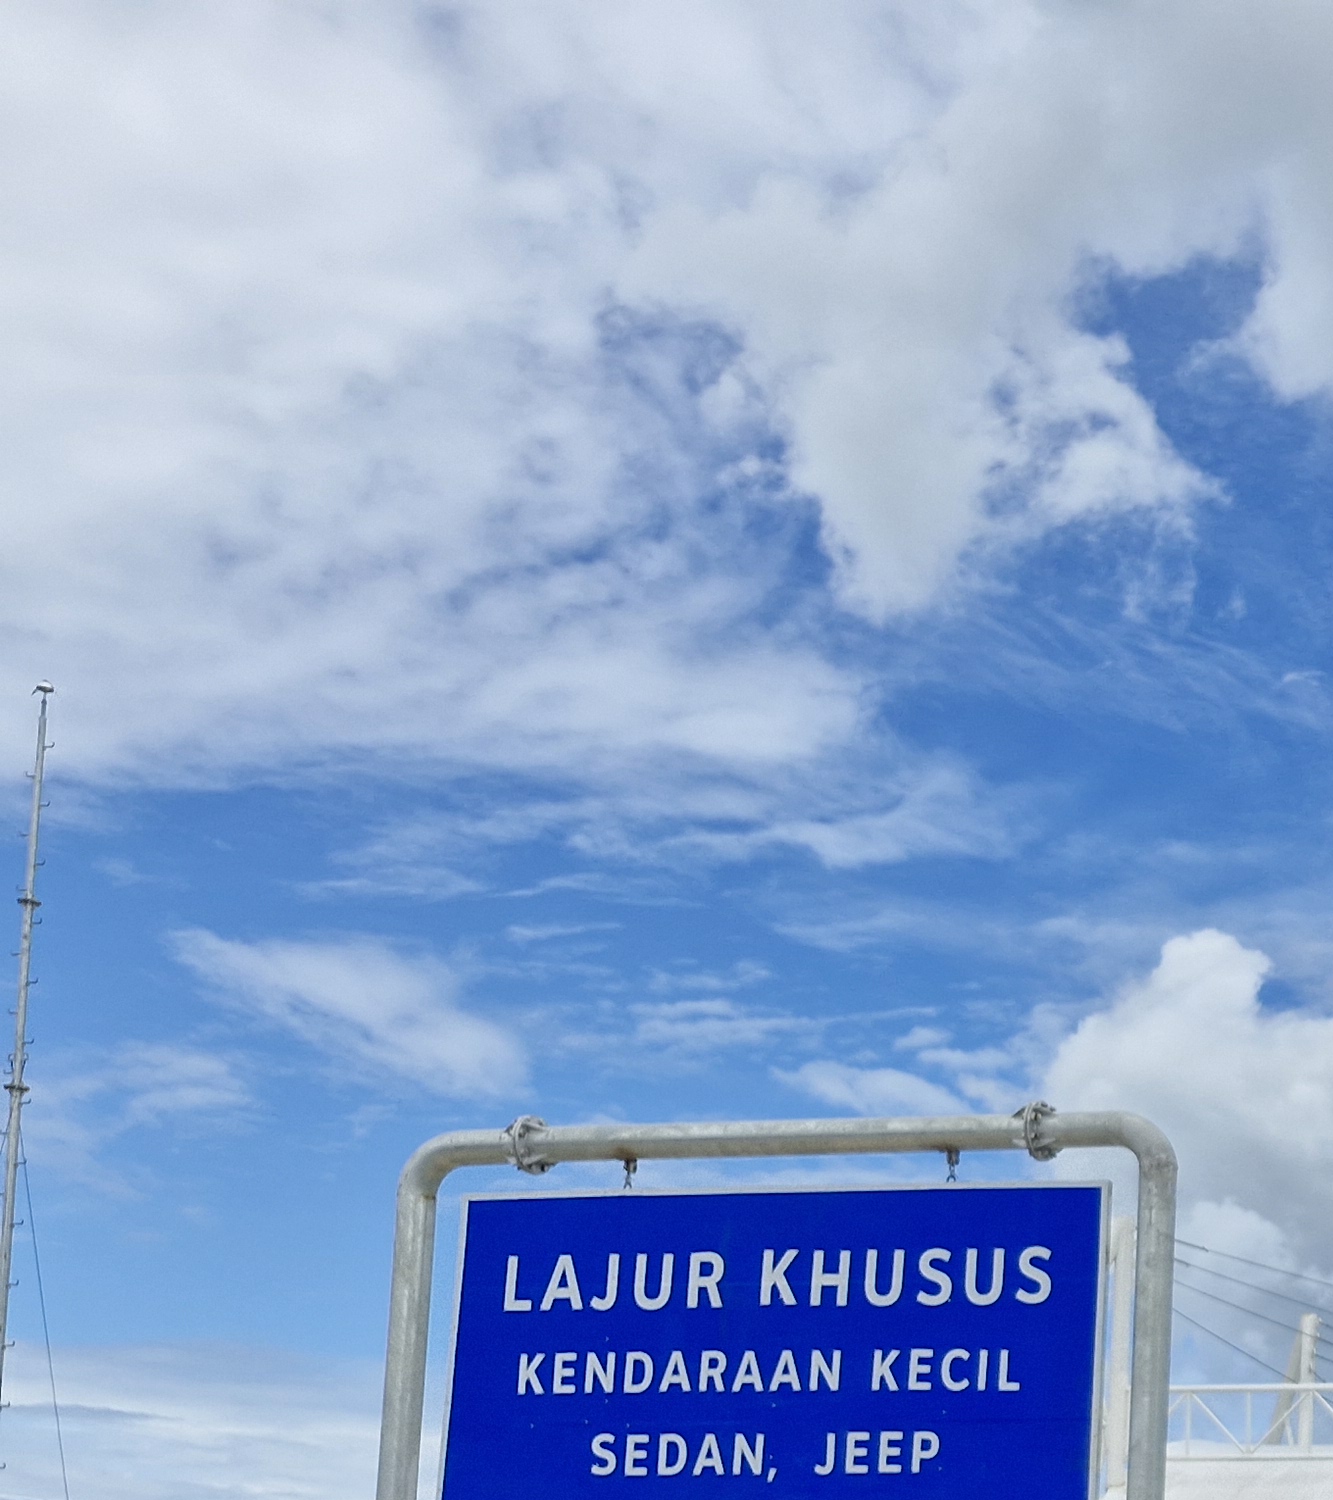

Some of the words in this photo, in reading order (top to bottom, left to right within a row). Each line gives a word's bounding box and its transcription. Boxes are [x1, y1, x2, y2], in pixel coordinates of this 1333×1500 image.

[503, 1252, 725, 1312] LAJUR
[760, 1246, 1052, 1307] KHUSUS
[517, 1350, 841, 1395] KENDARAAN
[871, 1348, 1020, 1392] KECIL
[591, 1433, 777, 1482] SEDAN,
[814, 1431, 940, 1475] JEEP
